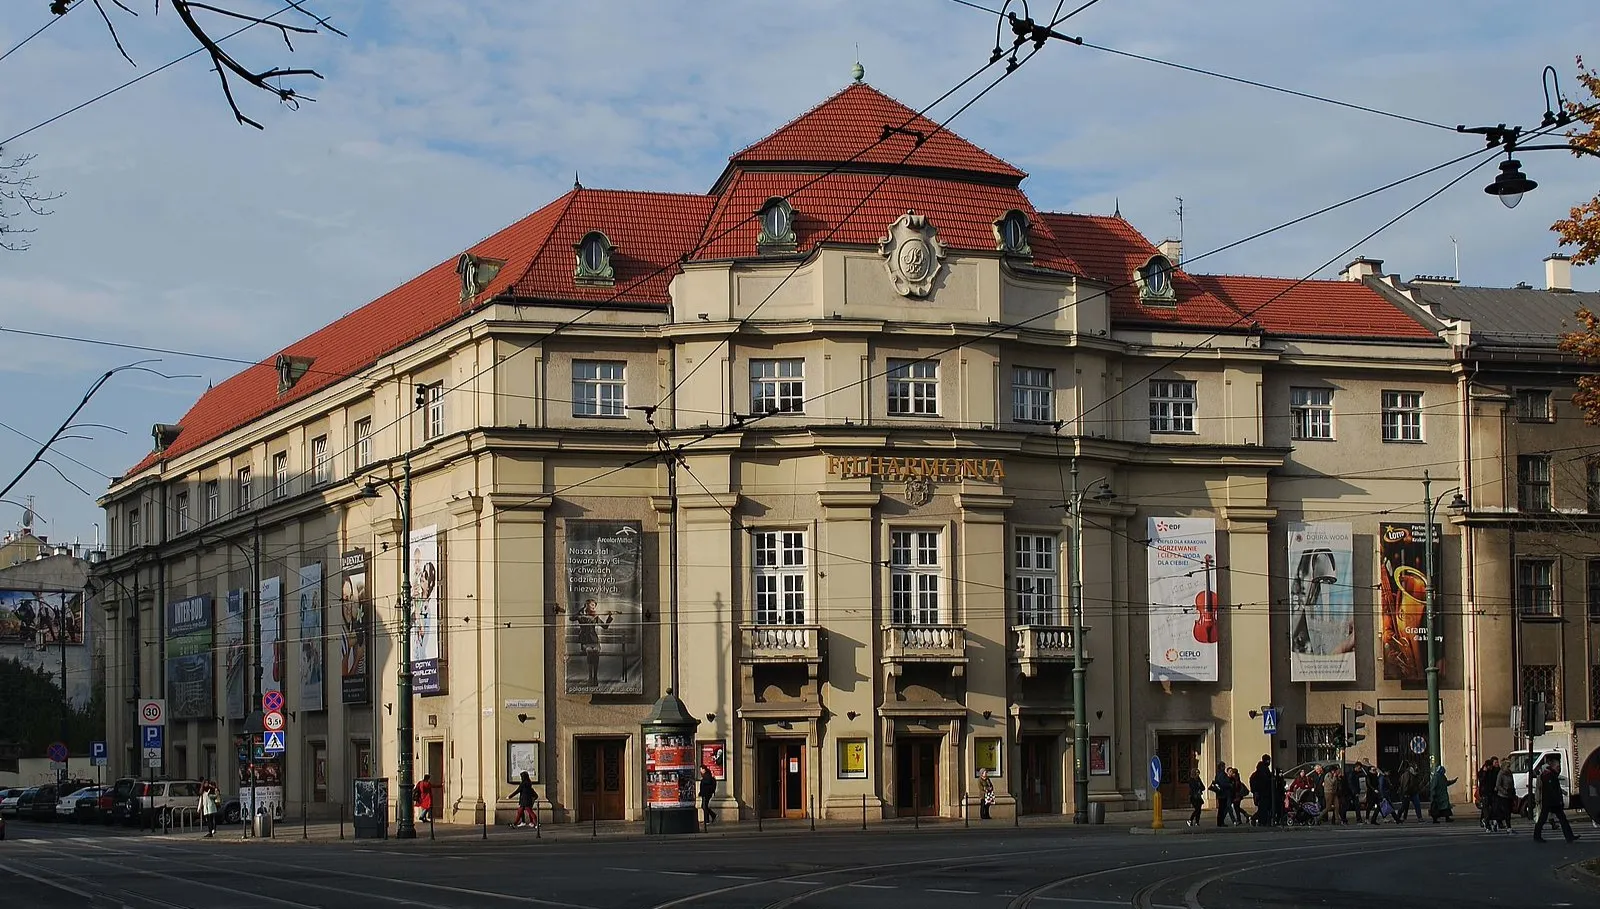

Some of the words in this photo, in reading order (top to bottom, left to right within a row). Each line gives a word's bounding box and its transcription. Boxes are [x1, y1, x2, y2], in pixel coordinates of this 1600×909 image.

[828, 455, 1006, 478] FILHARMONIA
[568, 547, 593, 555] Nasza
[594, 547, 609, 555] stal
[568, 575, 616, 584] codziennych
[145, 707, 158, 717] 30
[147, 727, 158, 742] P
[93, 743, 104, 757] P
